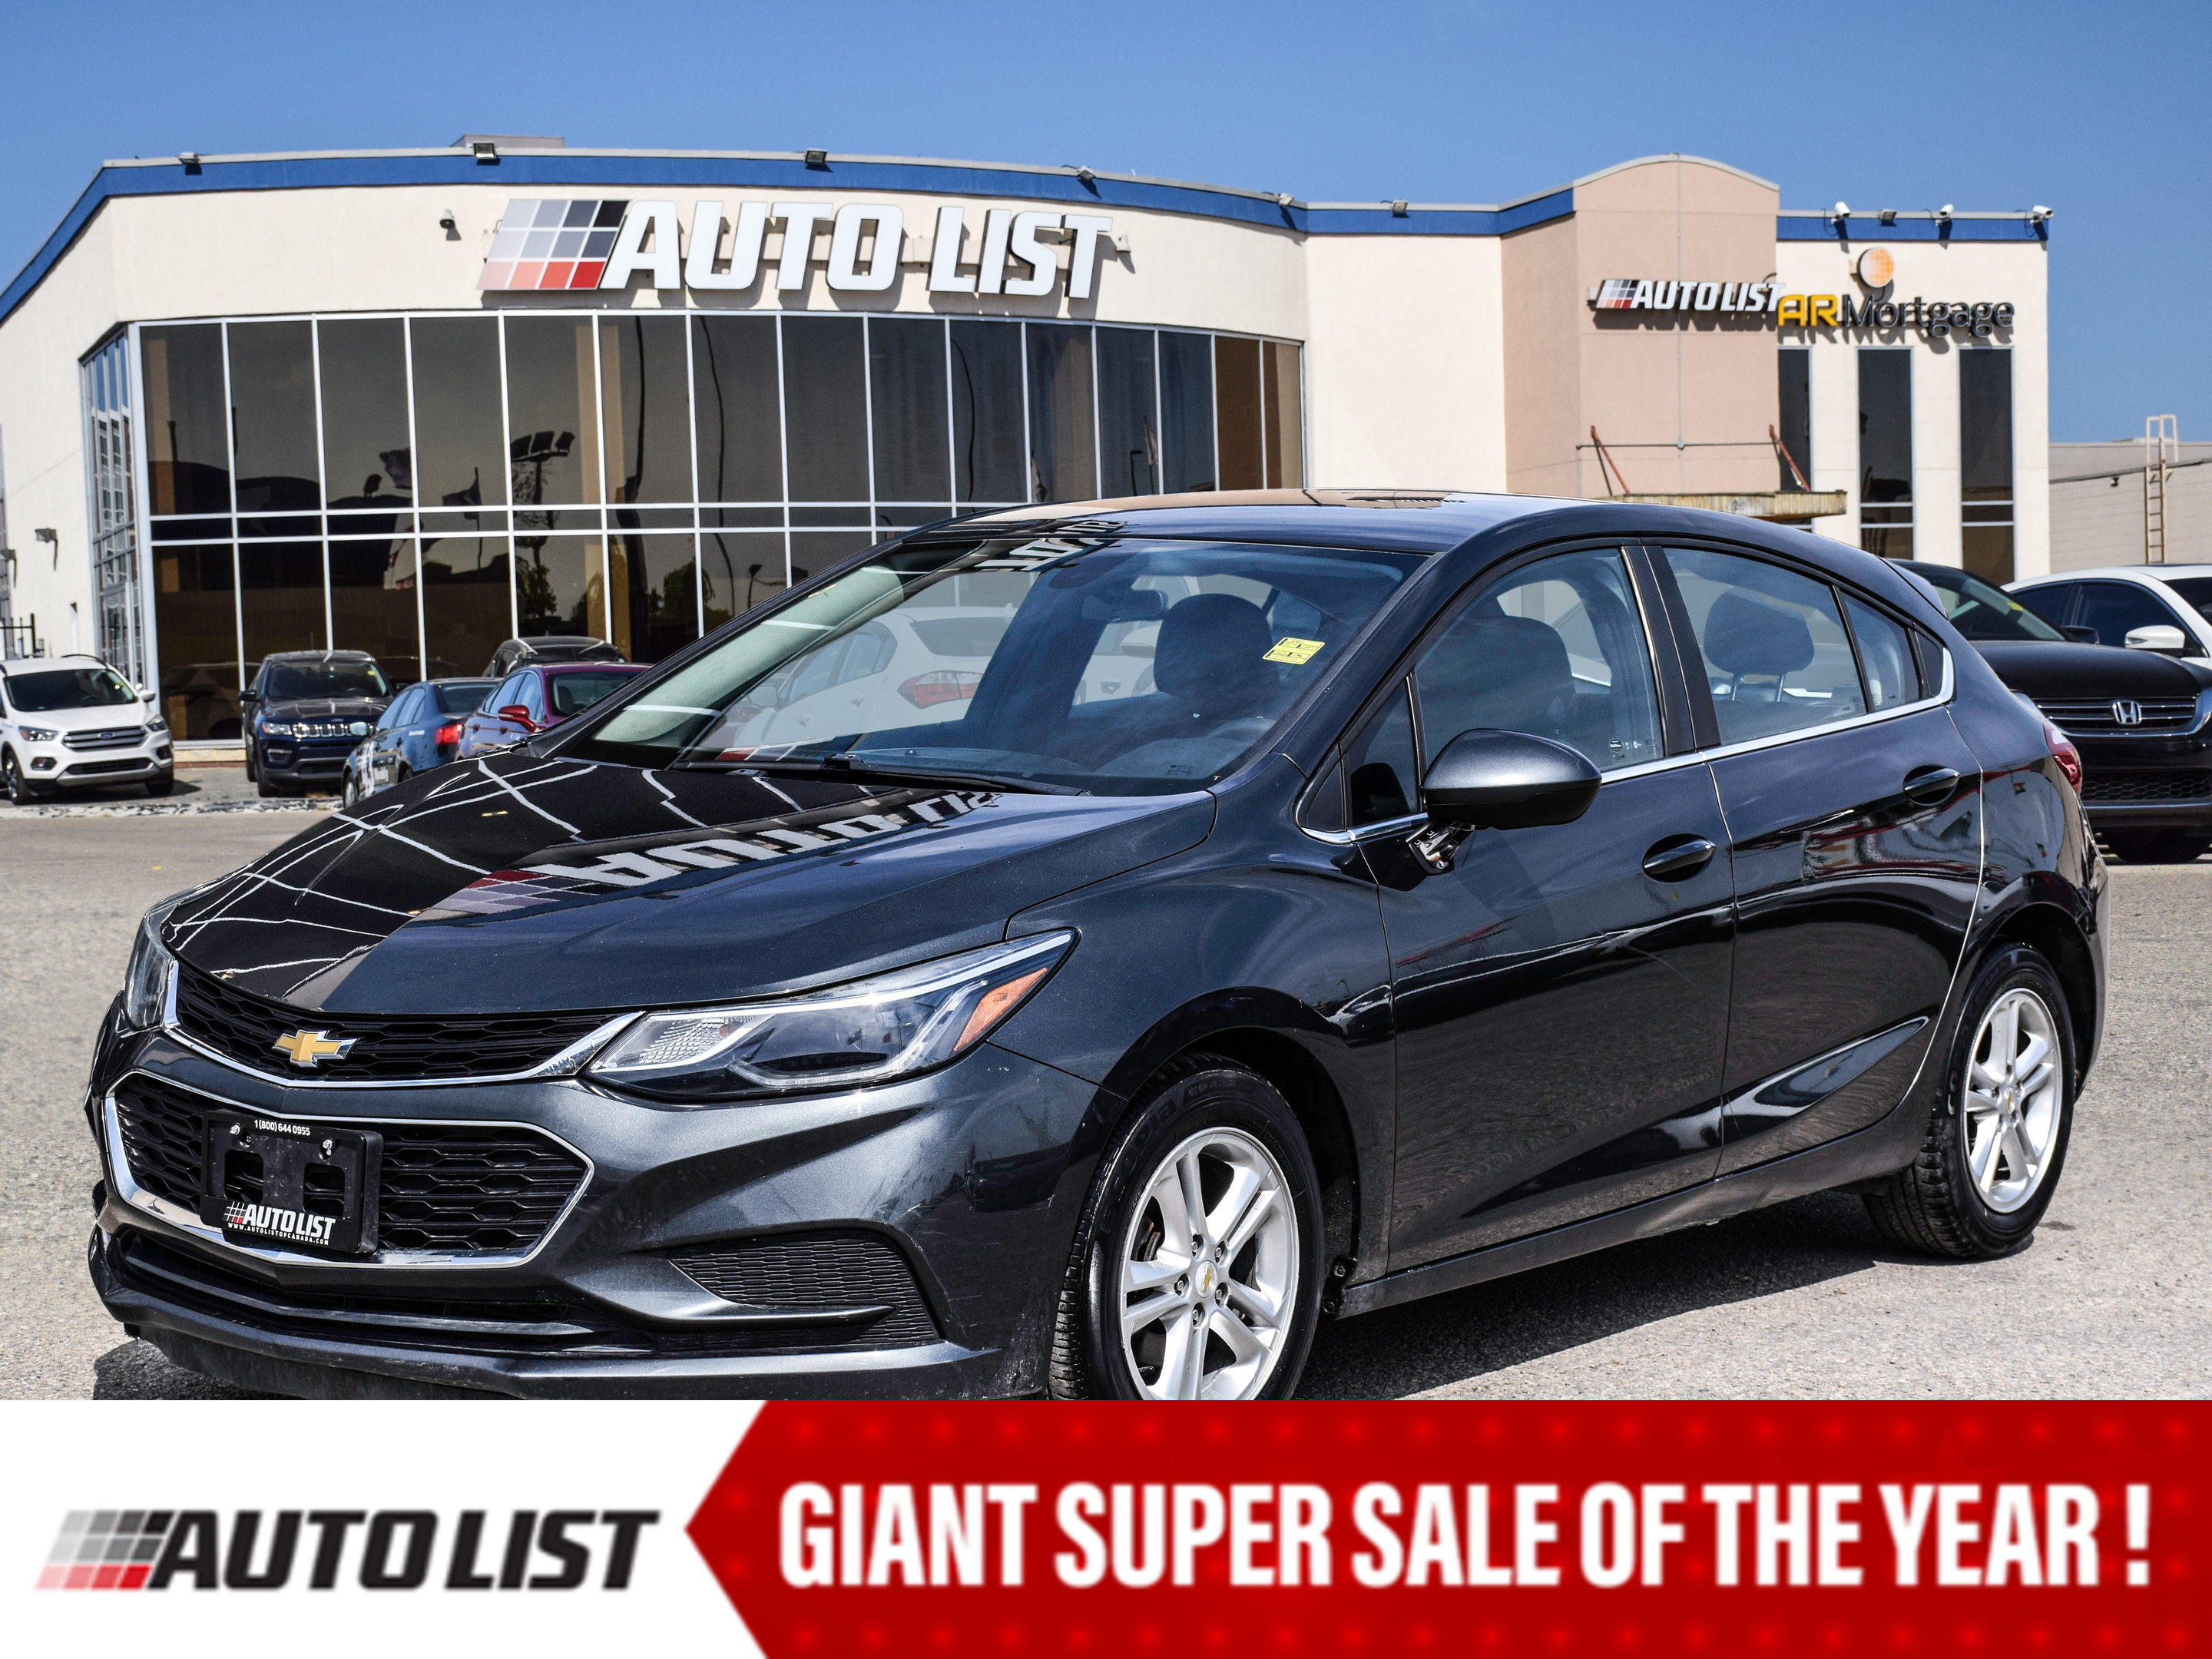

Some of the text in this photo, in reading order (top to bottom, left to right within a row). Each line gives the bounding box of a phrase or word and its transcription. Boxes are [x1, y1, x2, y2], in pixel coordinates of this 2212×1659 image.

[600, 200, 1113, 299] AUTO LIST
[1630, 280, 1786, 313] AUTO LIST
[1777, 293, 2015, 338] AR Mortgage
[254, 1119, 310, 1136] 1(800) 644 0955
[228, 1222, 329, 1246] WWW.AUTOLISTOFCANADA.COM
[242, 1204, 336, 1240] AUTO LIST
